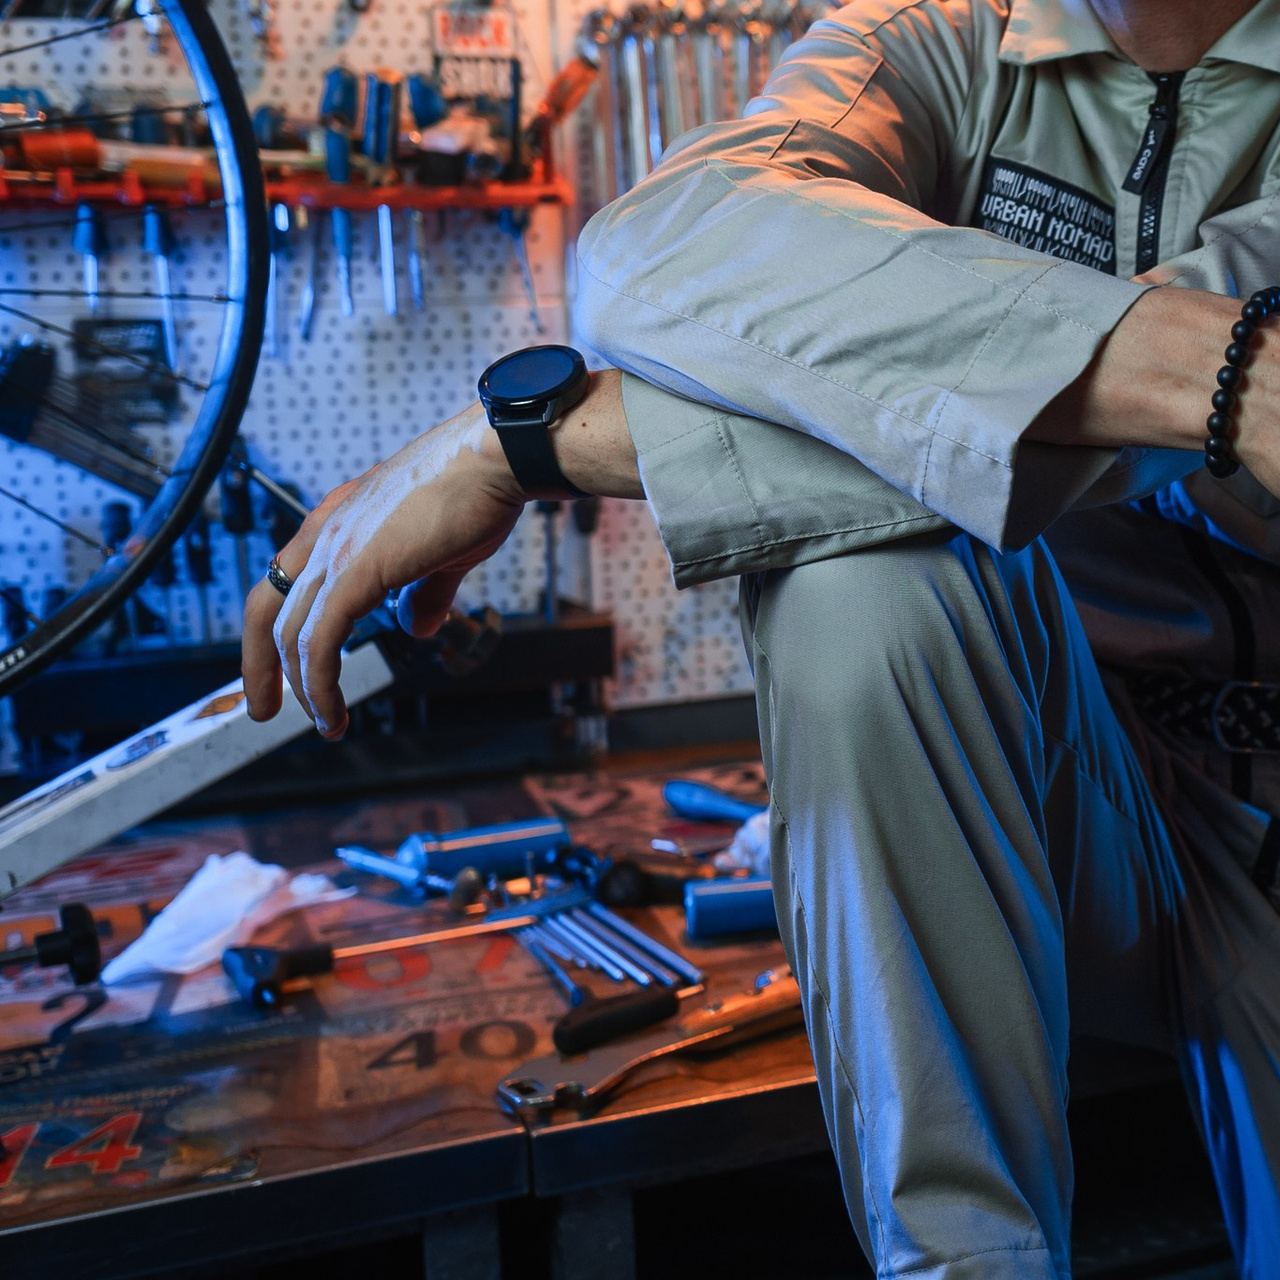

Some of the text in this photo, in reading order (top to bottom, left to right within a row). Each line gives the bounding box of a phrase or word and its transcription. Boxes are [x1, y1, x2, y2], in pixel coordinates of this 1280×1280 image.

[981, 193, 1115, 263] URBAN NOMAD
[365, 1020, 537, 1071] 40
